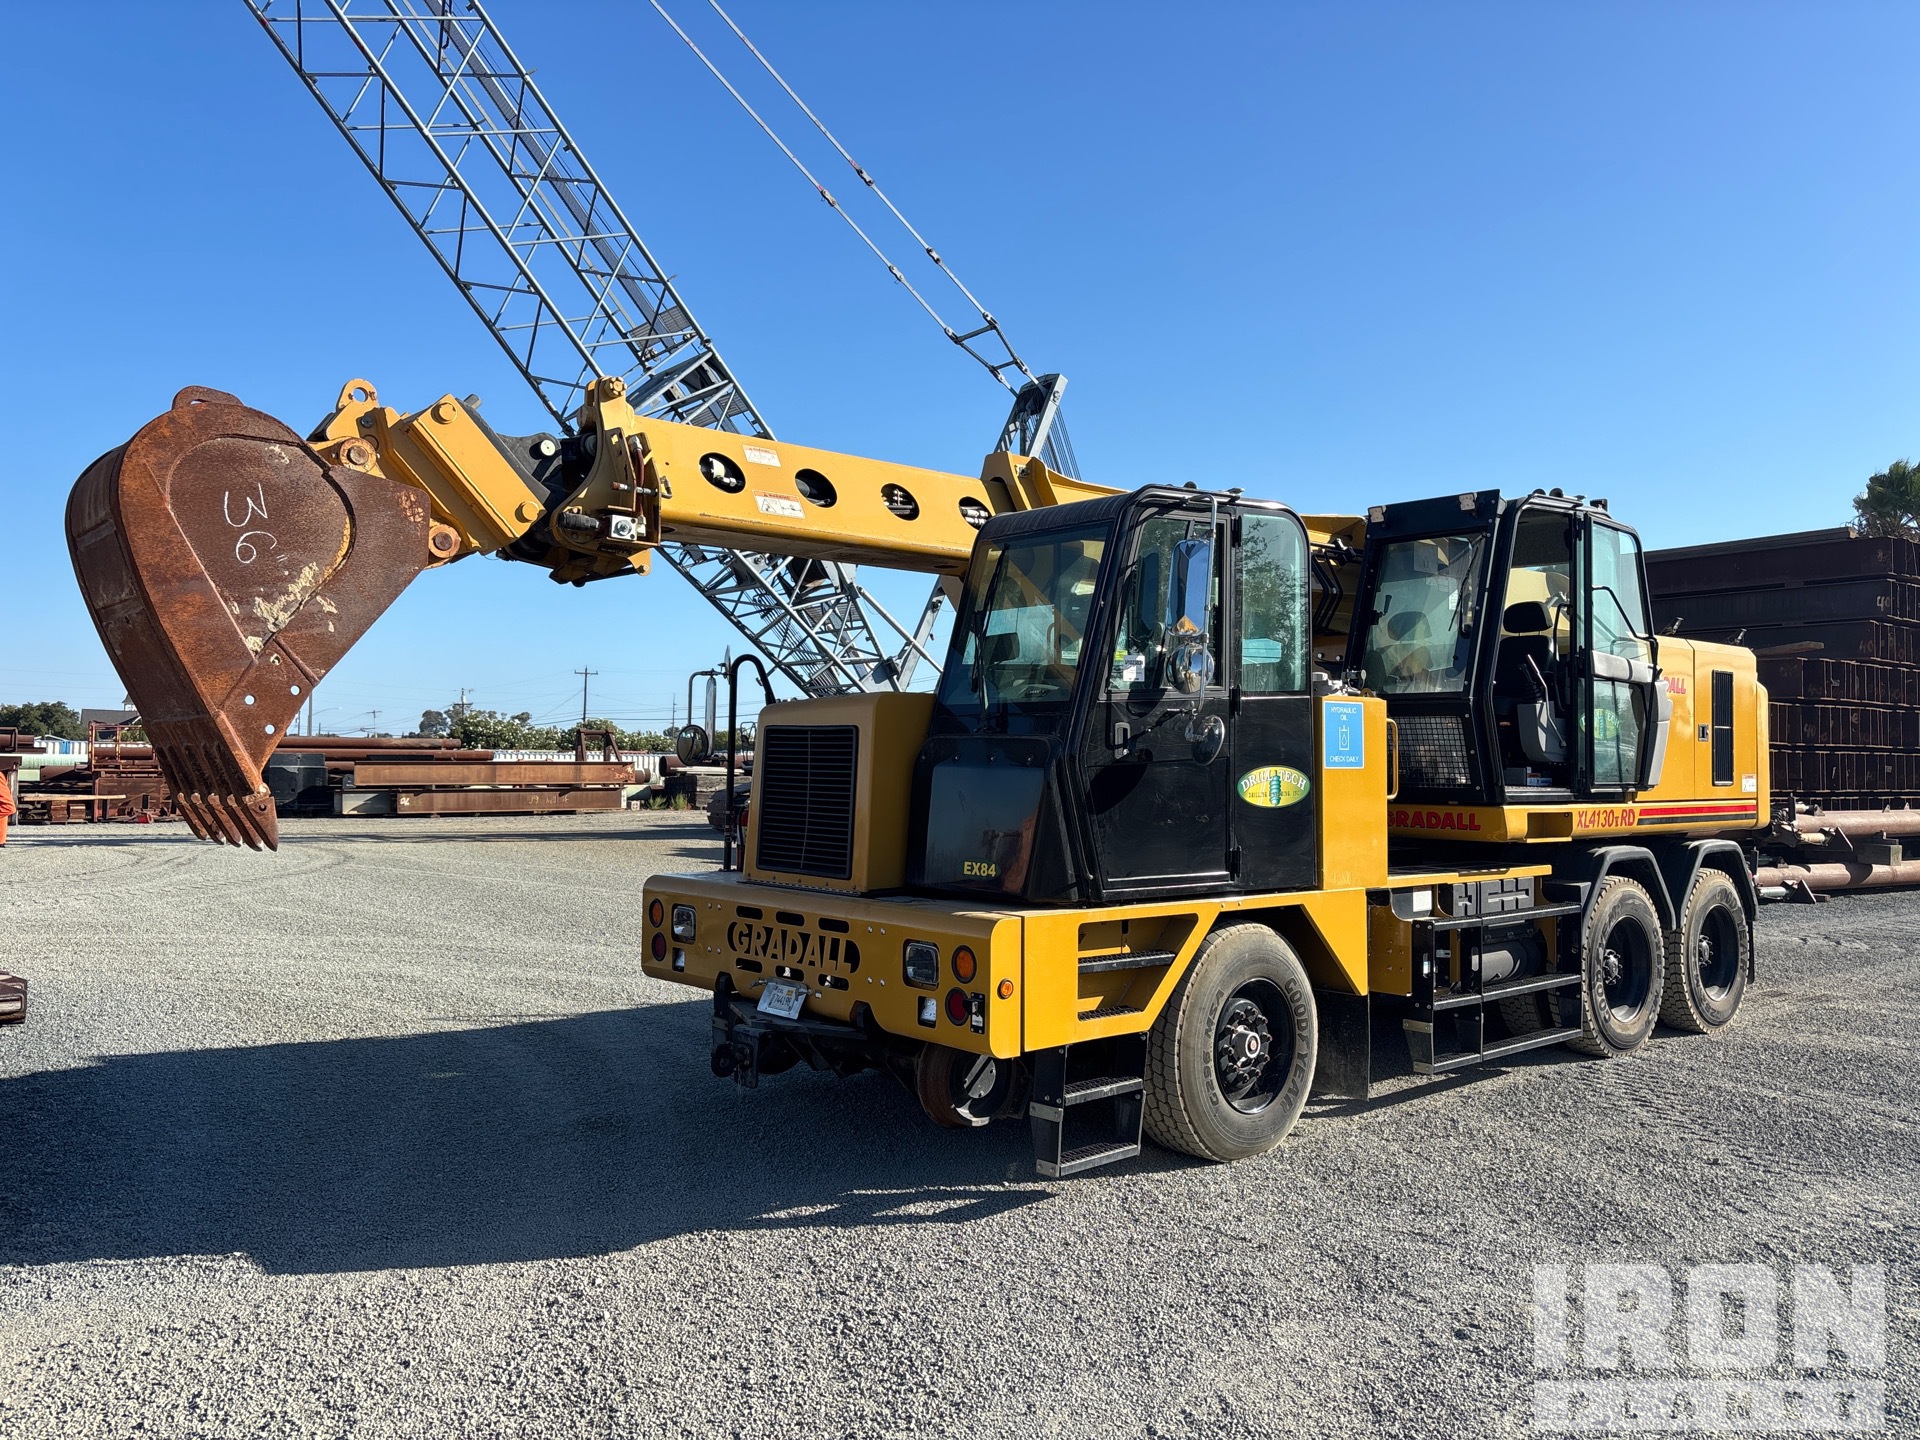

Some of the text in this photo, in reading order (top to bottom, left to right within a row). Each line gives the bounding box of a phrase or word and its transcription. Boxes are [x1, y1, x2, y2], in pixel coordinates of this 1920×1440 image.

[1663, 676, 1687, 695] DALL
[1330, 706, 1357, 714] HYDRAULIC
[1329, 755, 1359, 763] CHECK DAILY
[1240, 768, 1307, 792] DRILL TECH
[963, 861, 996, 877] EX84
[732, 922, 852, 974] GRADALL
